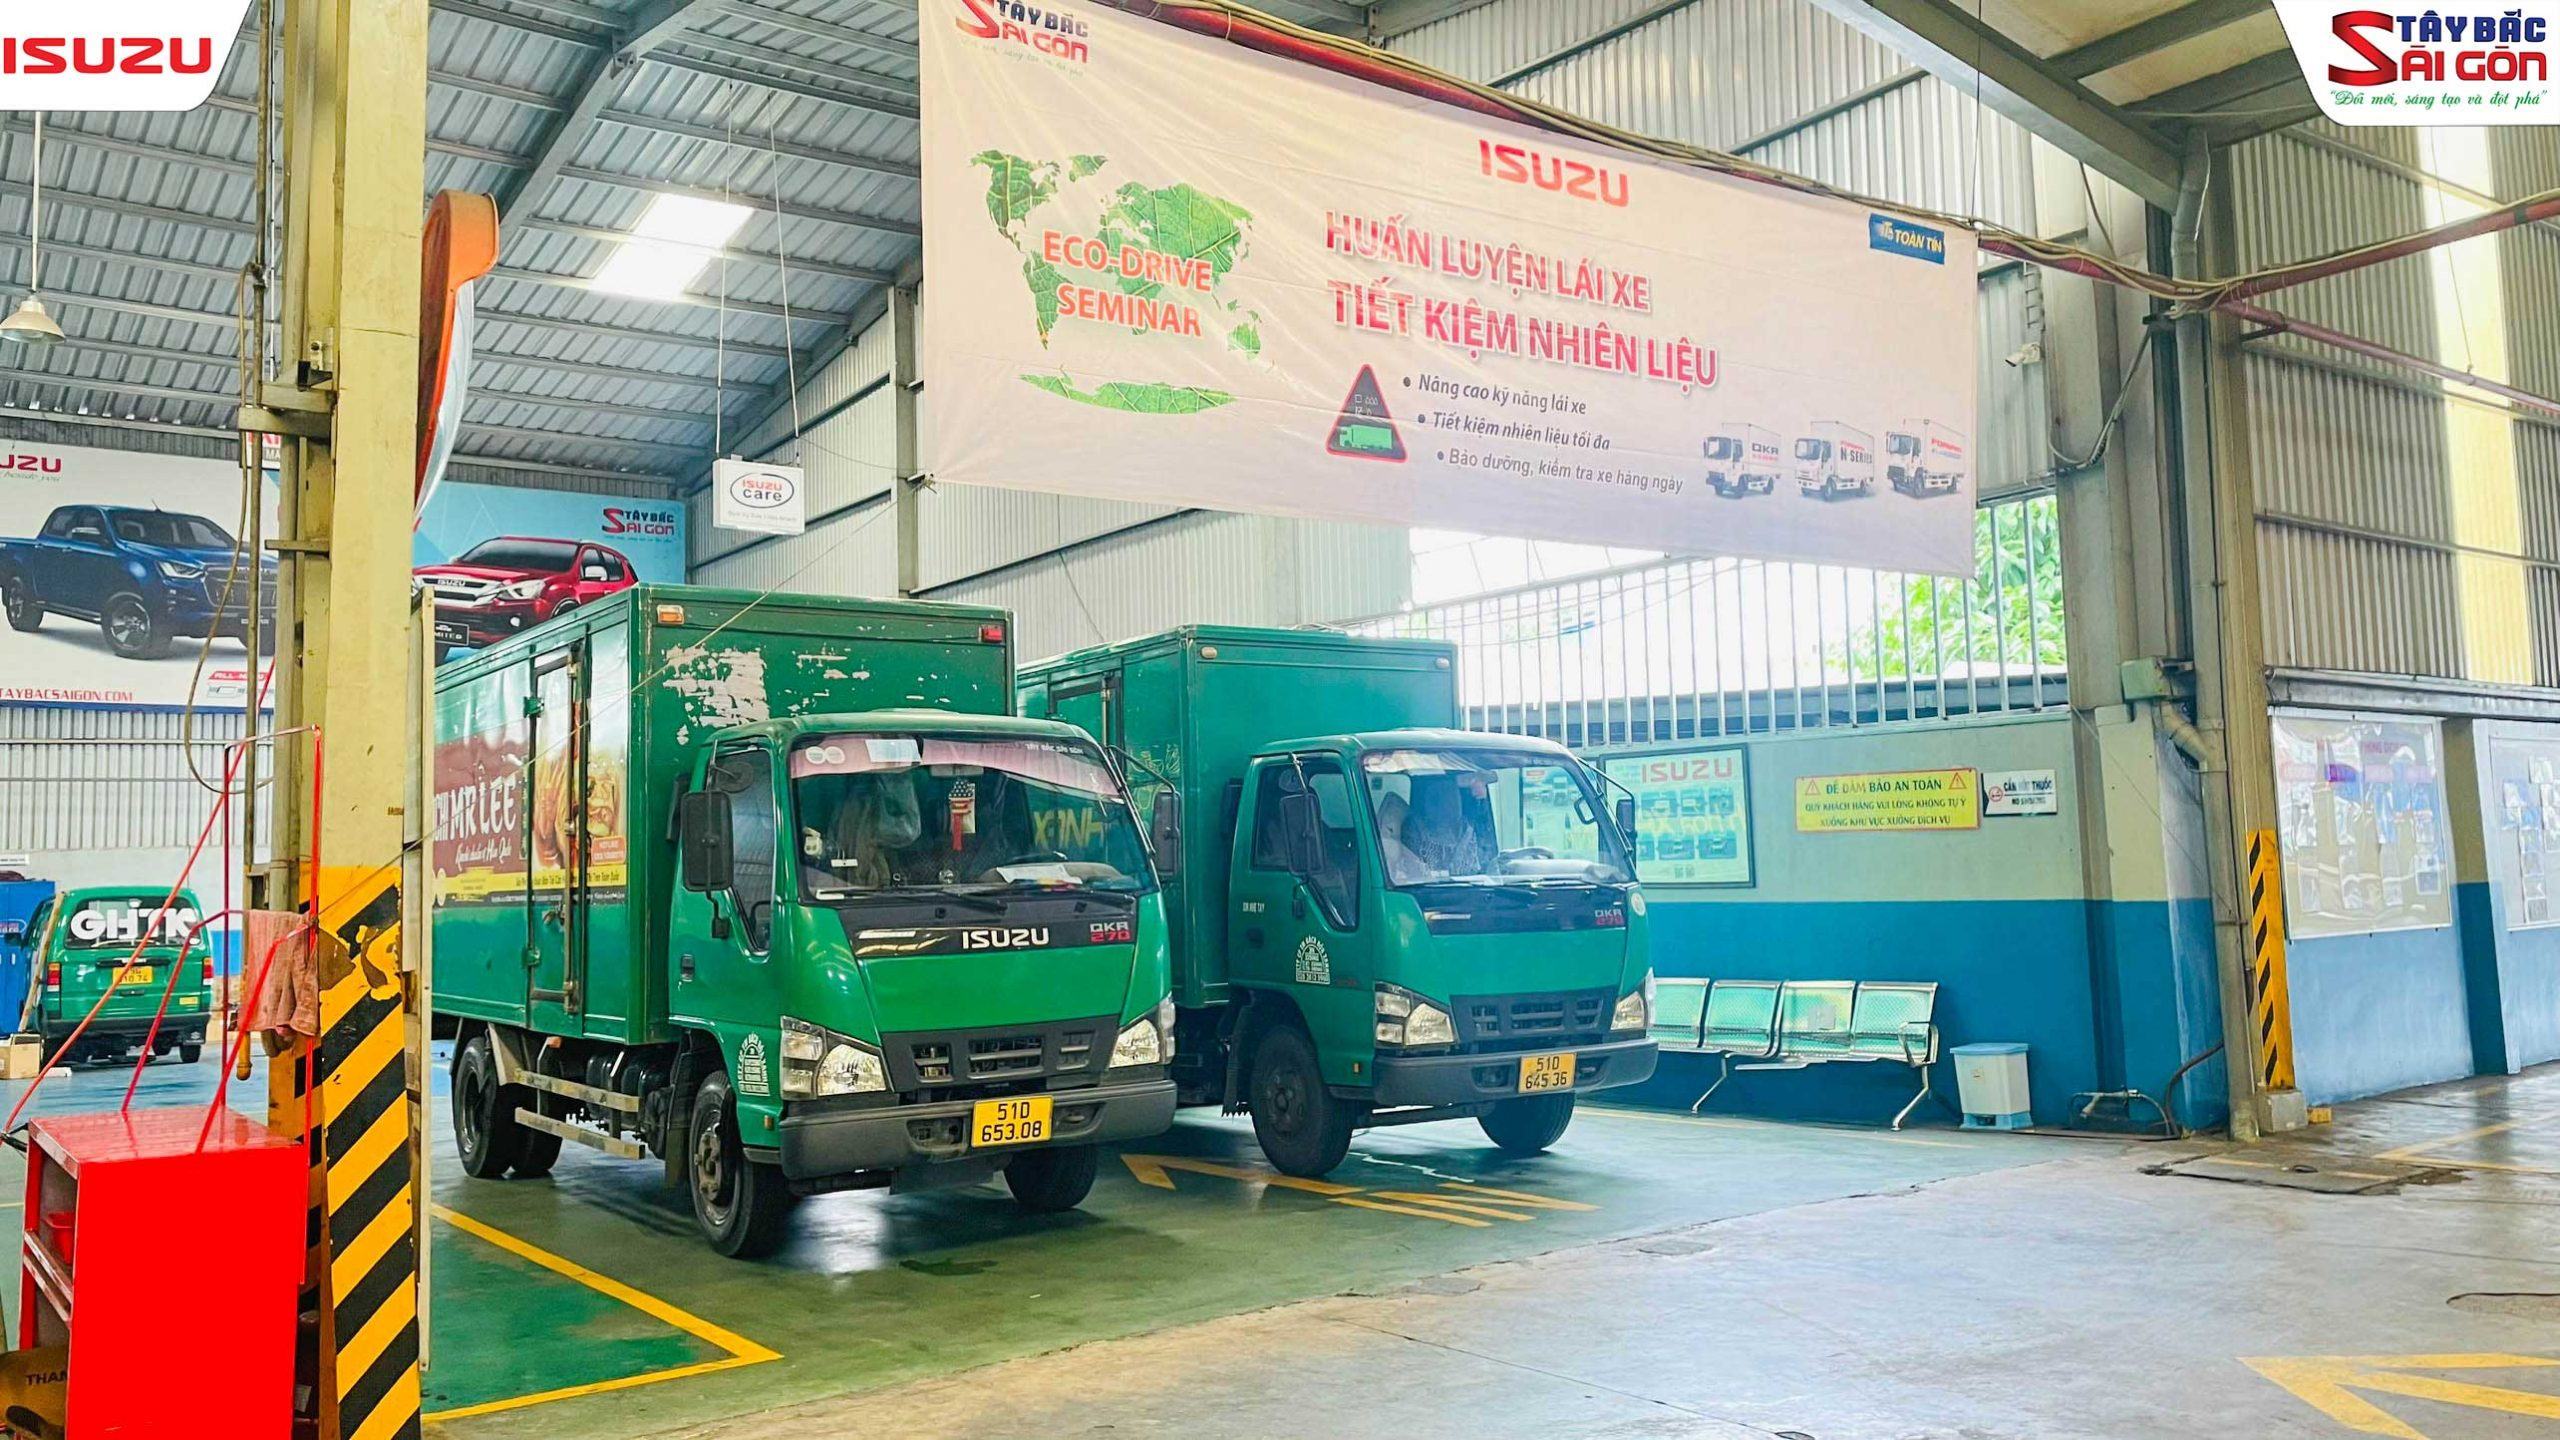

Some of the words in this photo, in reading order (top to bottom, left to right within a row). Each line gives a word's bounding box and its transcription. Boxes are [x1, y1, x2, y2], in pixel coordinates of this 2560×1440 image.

[1478, 139, 1629, 207] ISUZU
[1894, 230, 1925, 249] TOÀN
[1043, 229, 1212, 293] ECO-DRIVE
[1325, 210, 1433, 271] HUẤN
[1440, 234, 1548, 297] LUYỆN
[1556, 255, 1604, 307] LÁI
[1611, 270, 1651, 314] XE
[1056, 282, 1203, 338] SEMINAR
[1326, 276, 1415, 336] TIẾT
[1424, 298, 1520, 361] KIỆM
[1528, 316, 1640, 376] NHIÊN
[1646, 336, 1719, 396] LIỆU
[1419, 374, 1459, 400] Nâng
[1462, 384, 1490, 402] cao
[1512, 390, 1548, 414] năng
[1551, 394, 1569, 413] lái
[1571, 399, 1587, 415] xe
[1433, 411, 1462, 430] Tiết
[1464, 414, 1500, 439] kiệm
[1502, 421, 1542, 442] nhiên
[1545, 428, 1571, 449] liệu
[1593, 434, 1611, 451] đa
[1449, 448, 1479, 467] Bảo
[1482, 453, 1535, 477] dưỡng,
[1538, 459, 1572, 480] kiểm
[1575, 467, 1594, 482] tra
[1597, 470, 1613, 484] xe
[1652, 477, 1684, 496] ngày
[742, 480, 783, 491] ISUZU
[743, 488, 782, 502] care
[1642, 757, 1733, 783] ISUZU
[1894, 780, 1910, 791] AN
[478, 774, 517, 834] LEE
[1595, 909, 1622, 917] QKR
[1090, 921, 1129, 932] QKR
[1091, 930, 1131, 942] 270
[962, 927, 1049, 950] ISUZU
[1536, 1056, 1560, 1073] 51D
[997, 1101, 1031, 1121] 51D
[981, 1120, 1043, 1143] 653.08
